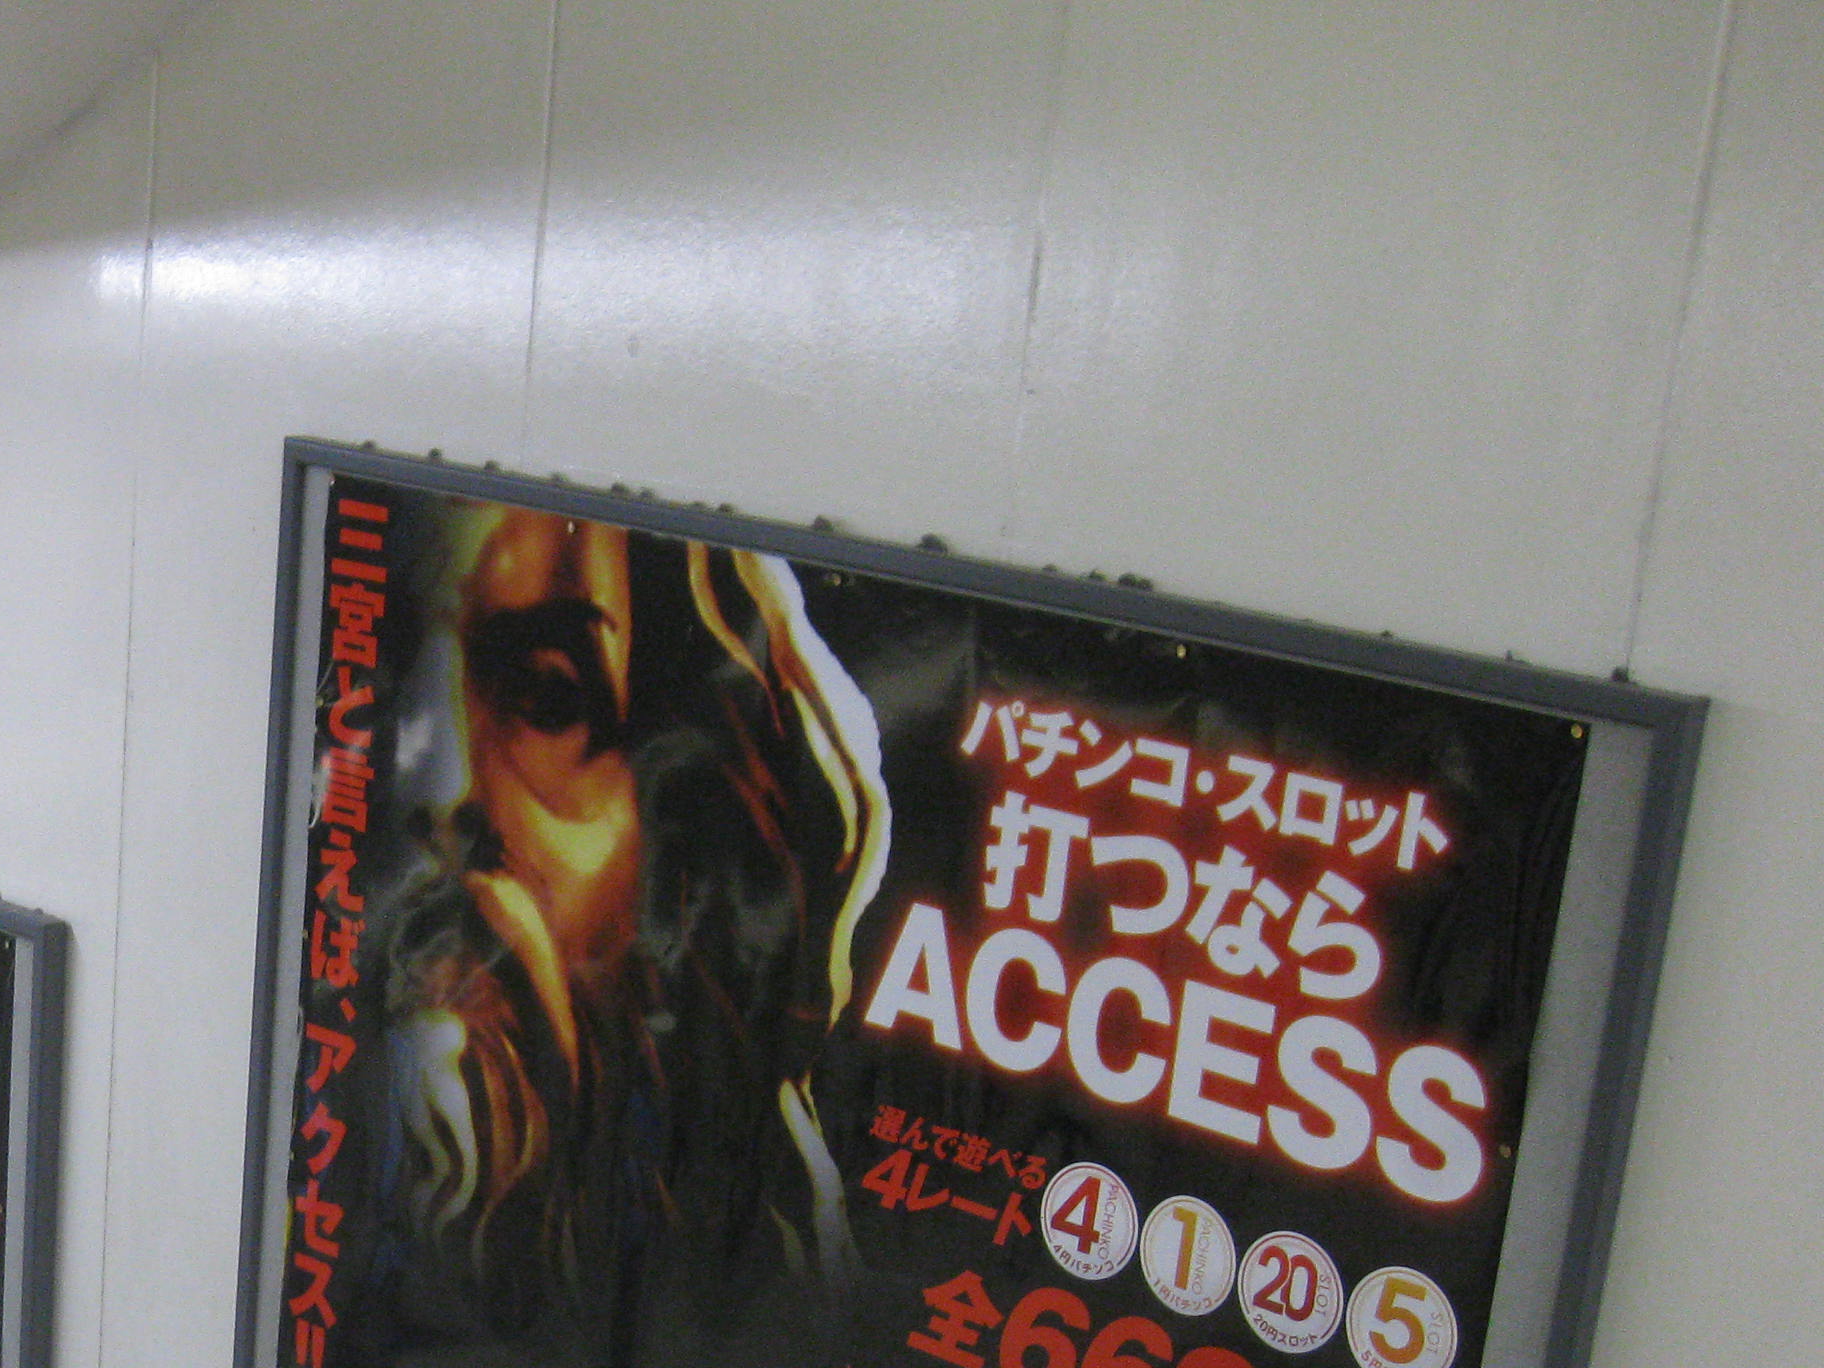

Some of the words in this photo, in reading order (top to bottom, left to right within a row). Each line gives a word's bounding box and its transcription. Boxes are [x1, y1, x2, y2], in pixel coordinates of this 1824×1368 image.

[960, 699, 1451, 872] パチンコ・スロット
[983, 790, 1382, 1000] 打つなら
[864, 902, 1487, 1203] ACCESS
[869, 1104, 1047, 1190] 選んで遊べる
[861, 1149, 1032, 1247] 4レート
[1050, 1175, 1102, 1255] 4
[1097, 1183, 1121, 1261] PACHINKO
[1052, 1244, 1115, 1276] 4円パチンコ
[1172, 1206, 1198, 1291] 1
[1253, 1244, 1319, 1322] 20
[1253, 1313, 1319, 1347] 20円スロット
[1368, 1276, 1428, 1365] 5
